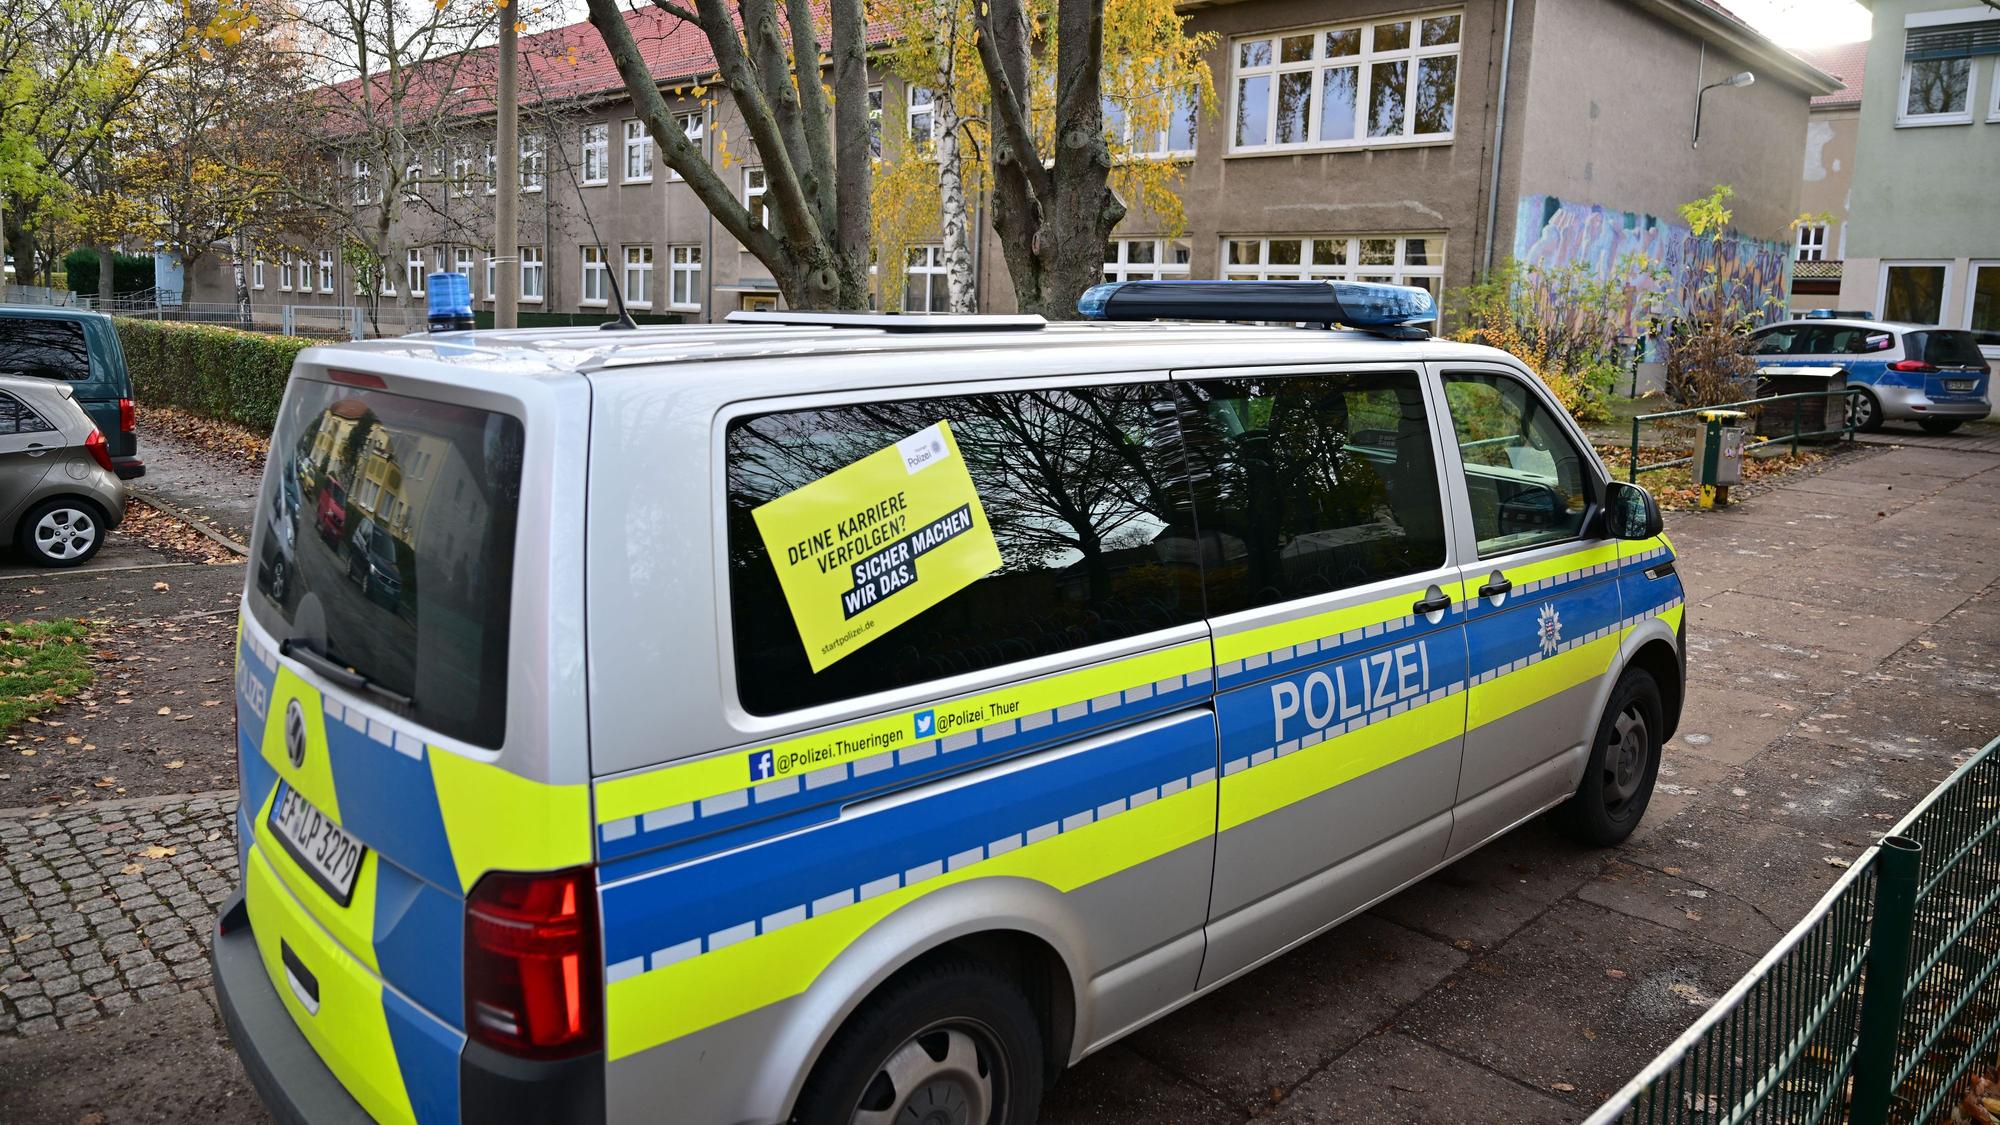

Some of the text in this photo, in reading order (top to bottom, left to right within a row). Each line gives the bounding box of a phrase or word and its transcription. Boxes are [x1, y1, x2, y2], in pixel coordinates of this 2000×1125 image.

[907, 449, 932, 468] Polizei
[788, 492, 908, 566] DEINE KARRIERE
[817, 514, 907, 574] VERFOLGEN?
[854, 508, 970, 585] SICHER MACHEN
[844, 565, 915, 614] WIR DAS.
[821, 619, 875, 655] startpolizei.de
[937, 699, 1020, 733] @Polizei_Thuer
[1271, 640, 1429, 742] POLIZEI
[776, 727, 904, 774] @Polizei.Thueringen
[316, 820, 358, 884] 3279
